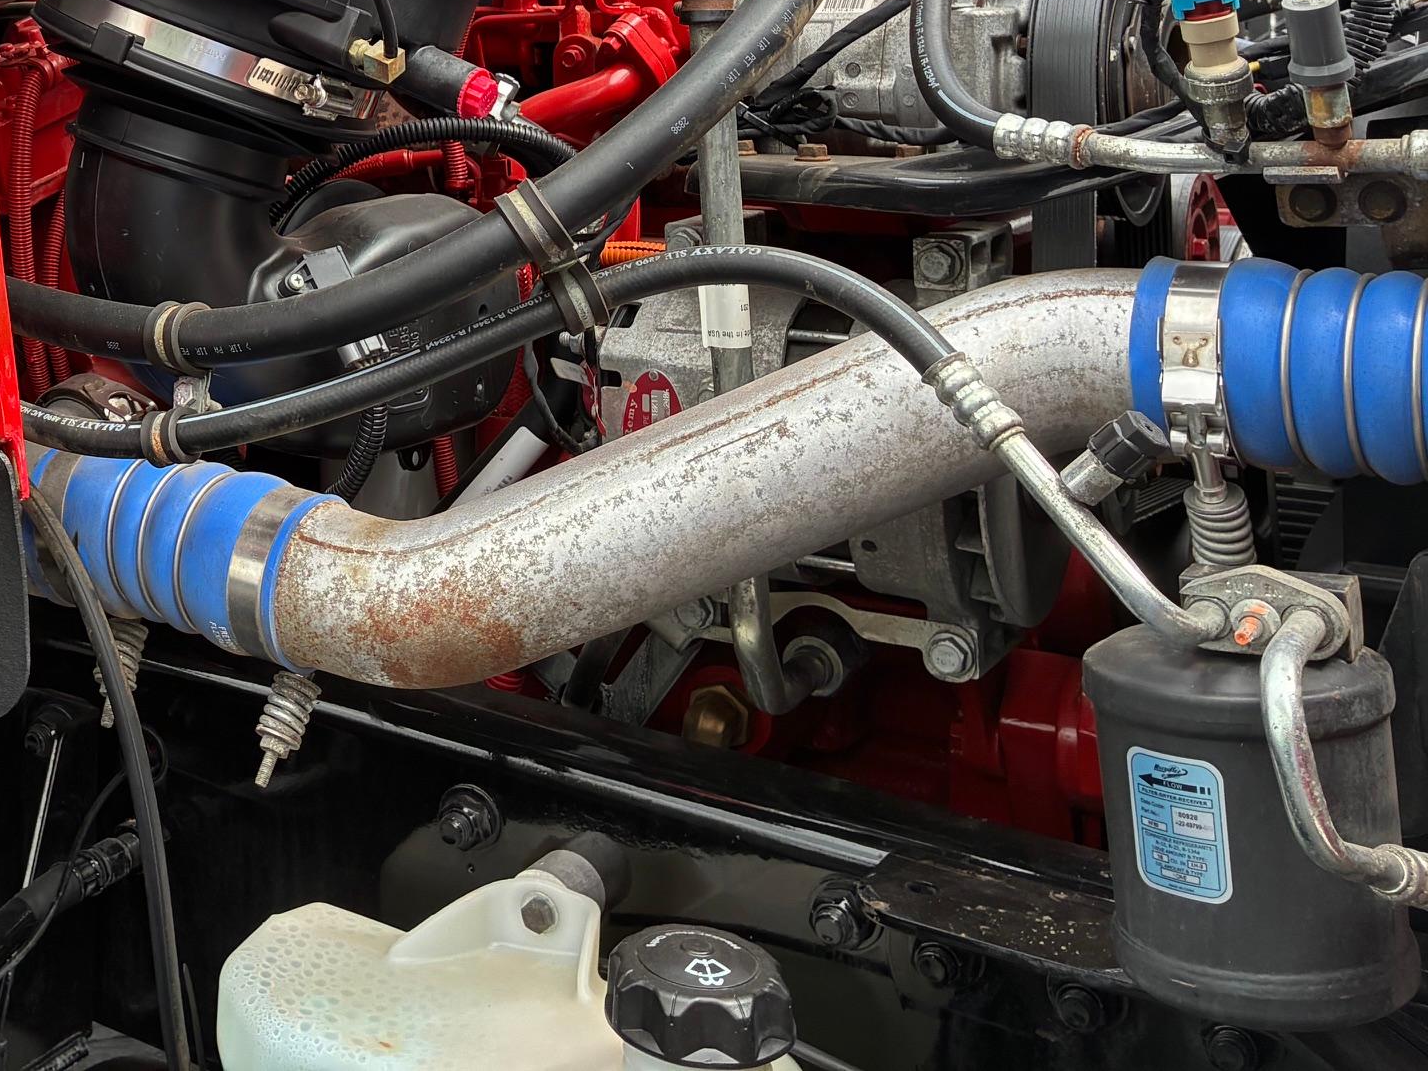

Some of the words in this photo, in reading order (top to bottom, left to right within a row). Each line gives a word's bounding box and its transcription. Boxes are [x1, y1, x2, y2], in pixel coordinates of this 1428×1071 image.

[921, 57, 940, 89] R-1234yf
[665, 249, 687, 260] SLE
[691, 246, 762, 256] GALAXY
[592, 269, 613, 280] HOS
[707, 330, 721, 338] USA
[77, 423, 126, 432] GALAXY
[1162, 780, 1183, 790] FLOW
